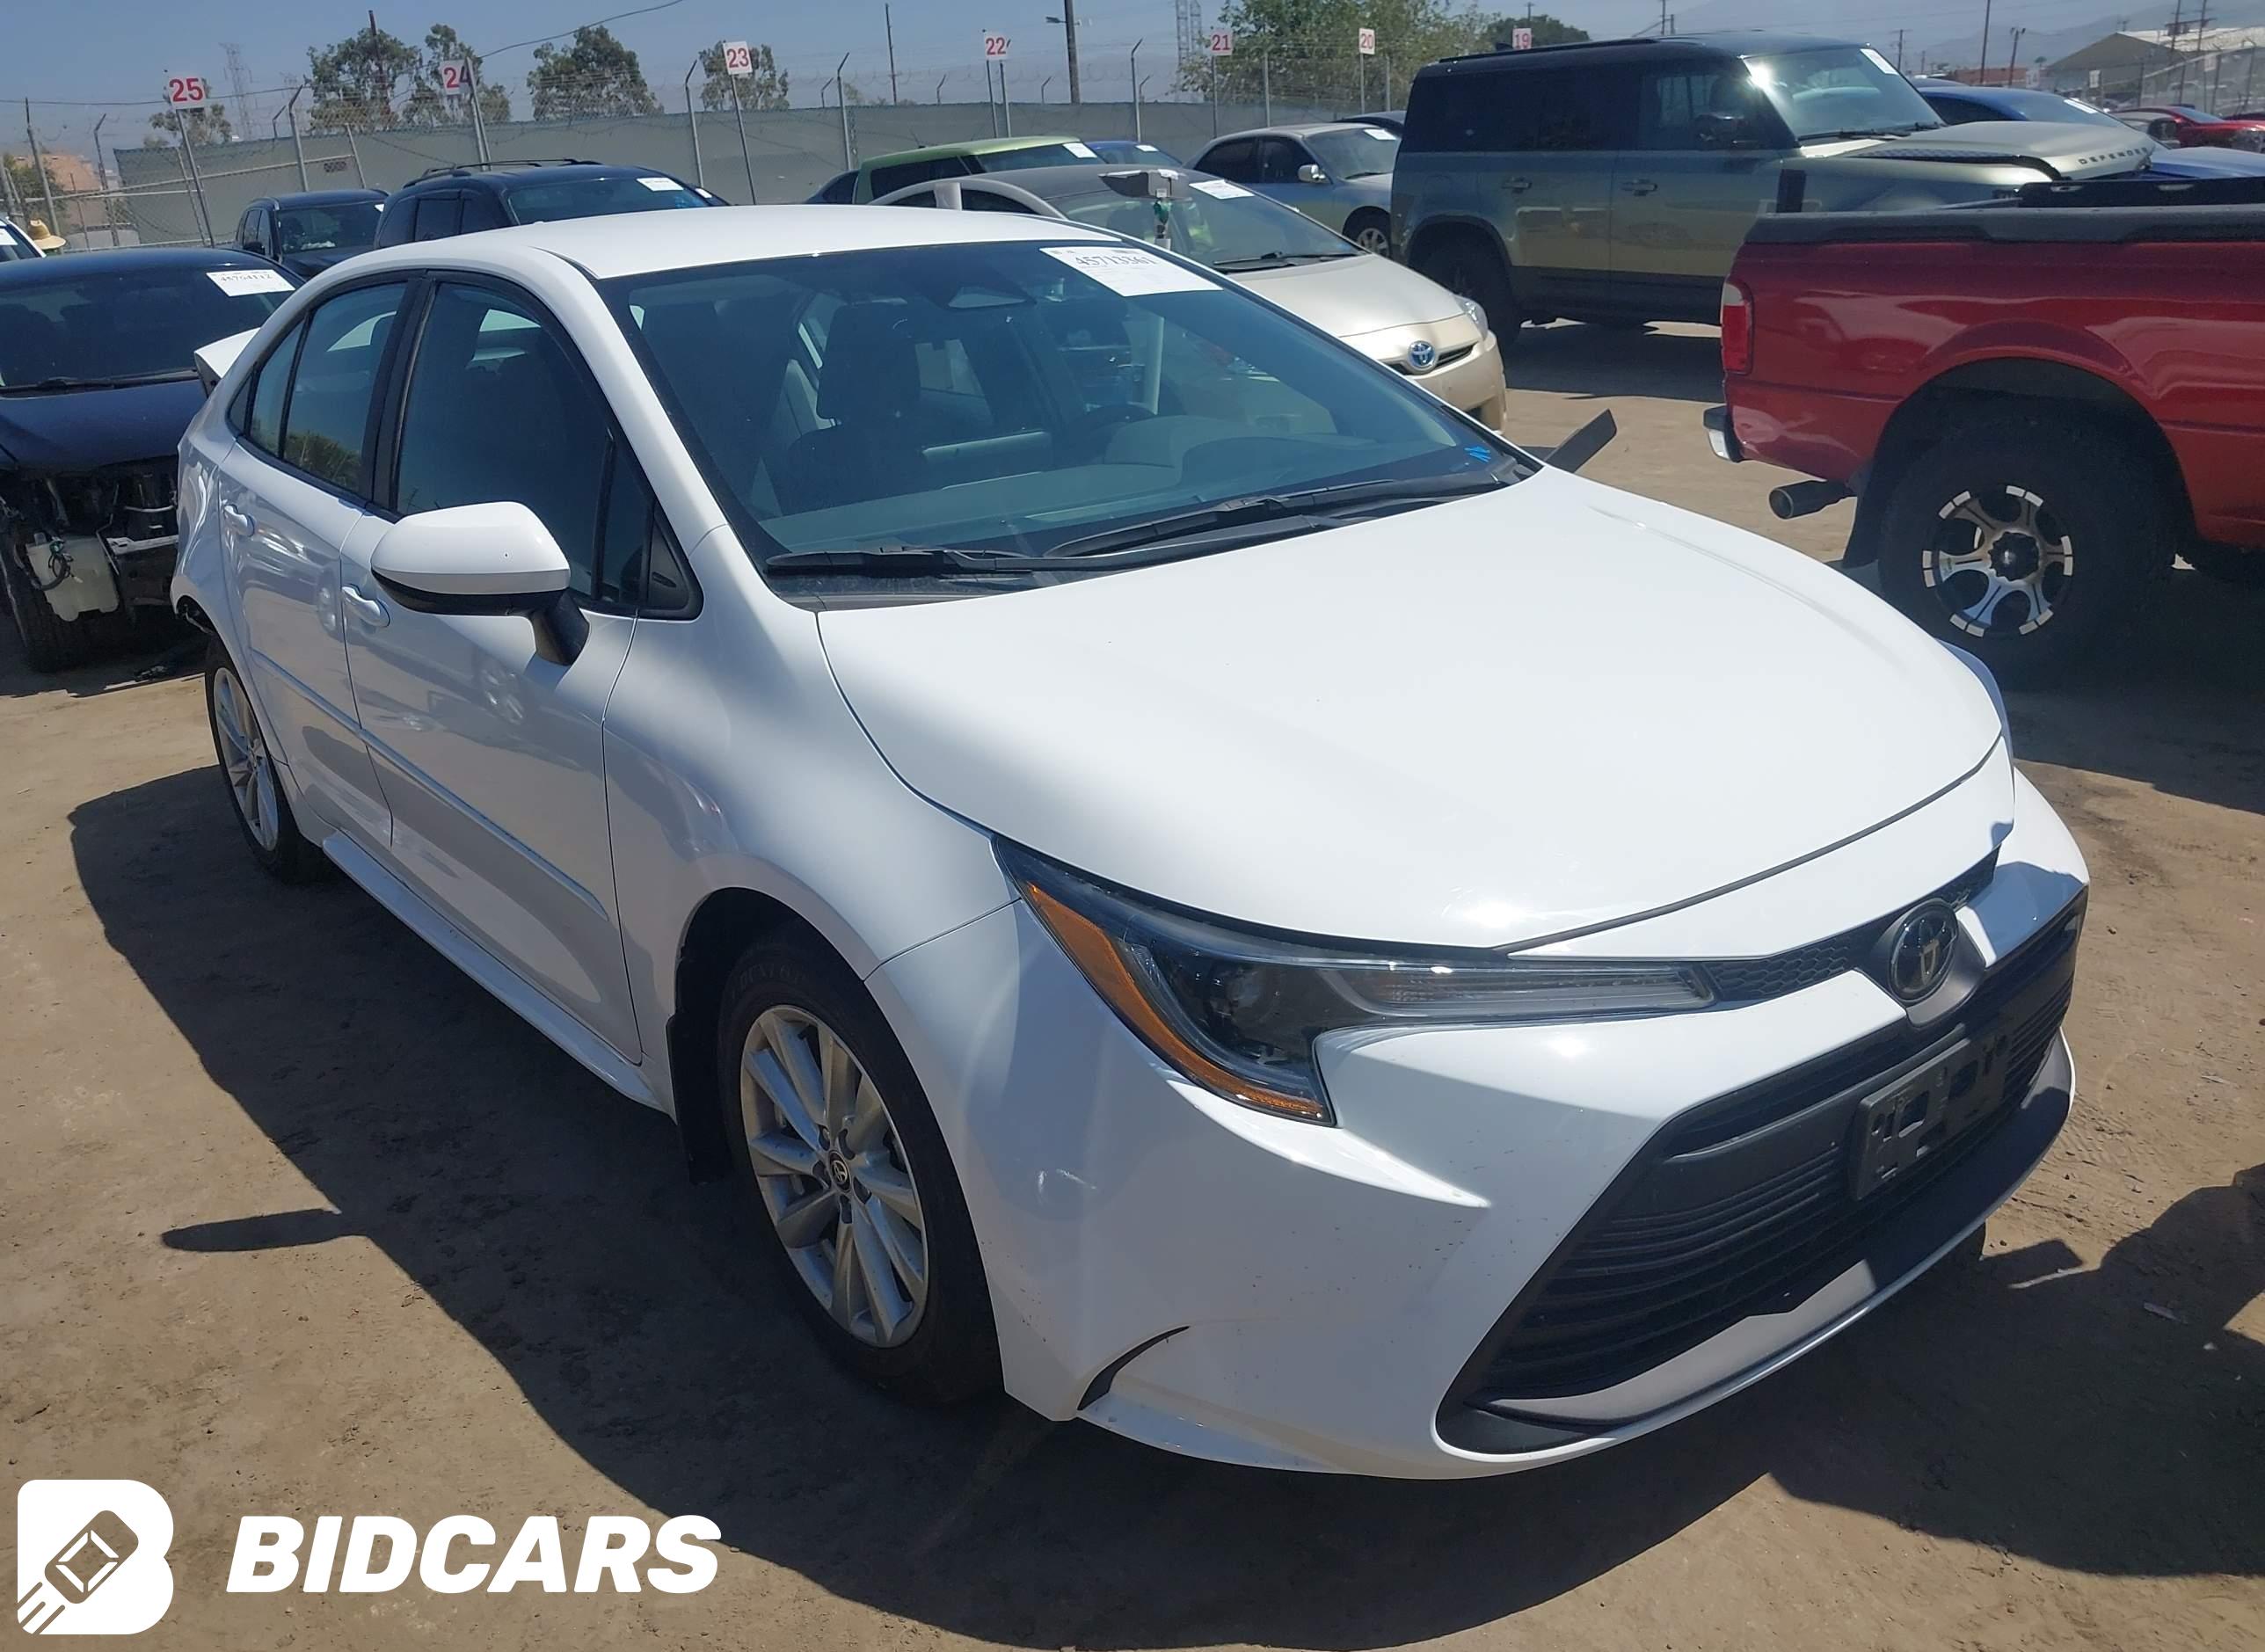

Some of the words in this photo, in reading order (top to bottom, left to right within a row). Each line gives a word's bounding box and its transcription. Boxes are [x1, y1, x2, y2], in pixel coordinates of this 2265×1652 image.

[986, 37, 1006, 55] 22
[1212, 34, 1230, 50] 21
[1361, 33, 1374, 49] 20
[1516, 33, 1530, 48] 19
[726, 47, 749, 68] 23
[444, 66, 473, 88] 24
[169, 77, 203, 101] 25
